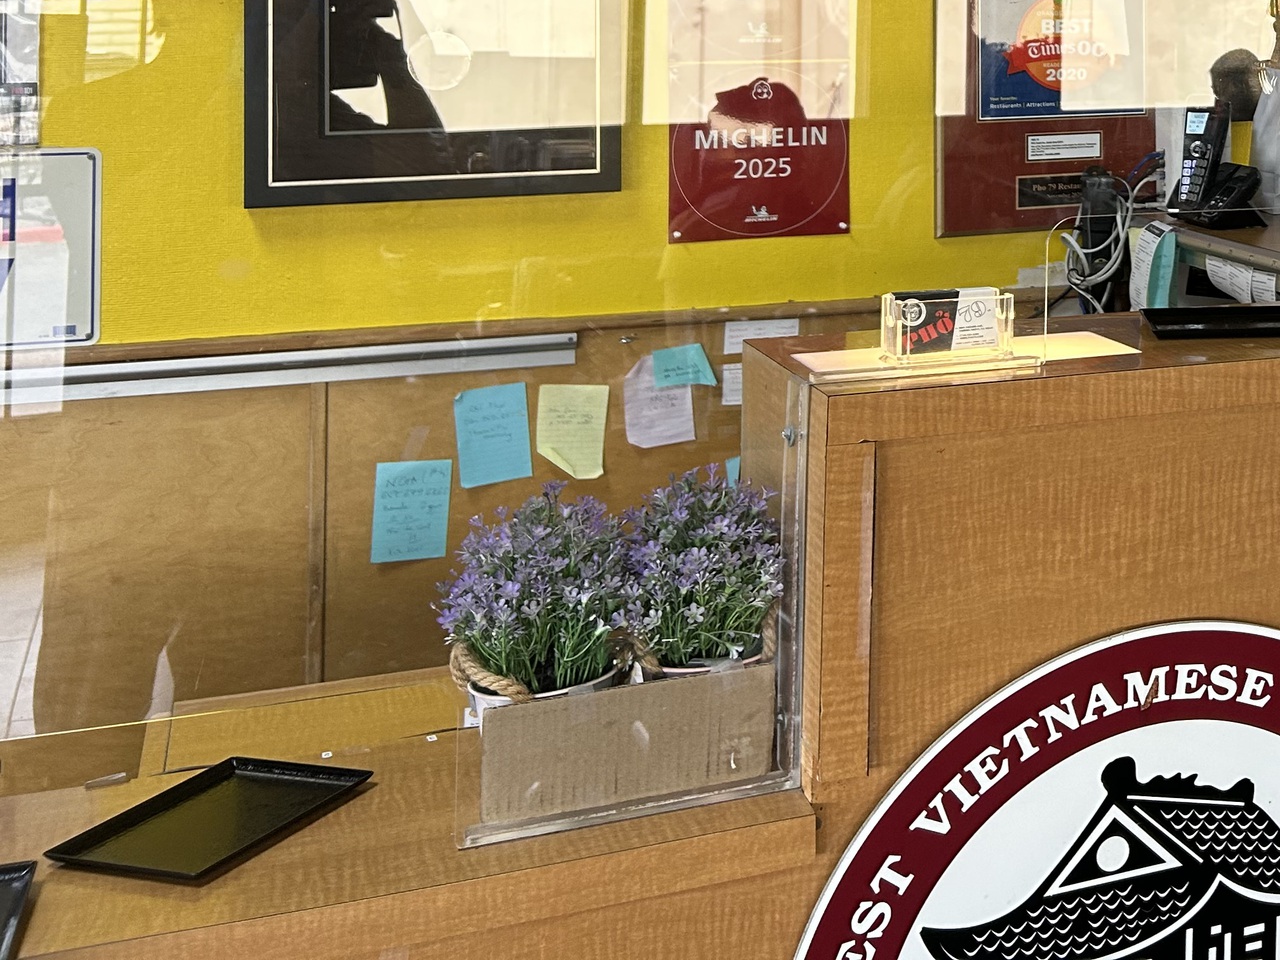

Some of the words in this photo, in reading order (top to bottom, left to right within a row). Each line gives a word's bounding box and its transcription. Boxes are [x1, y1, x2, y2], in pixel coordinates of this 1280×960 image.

[1041, 18, 1092, 34] BEST
[1046, 68, 1087, 81] 2020
[695, 126, 827, 150] MICHELIN
[734, 158, 792, 179] 2025
[958, 300, 986, 323] 79
[909, 663, 1274, 836] VIETNAMESE
